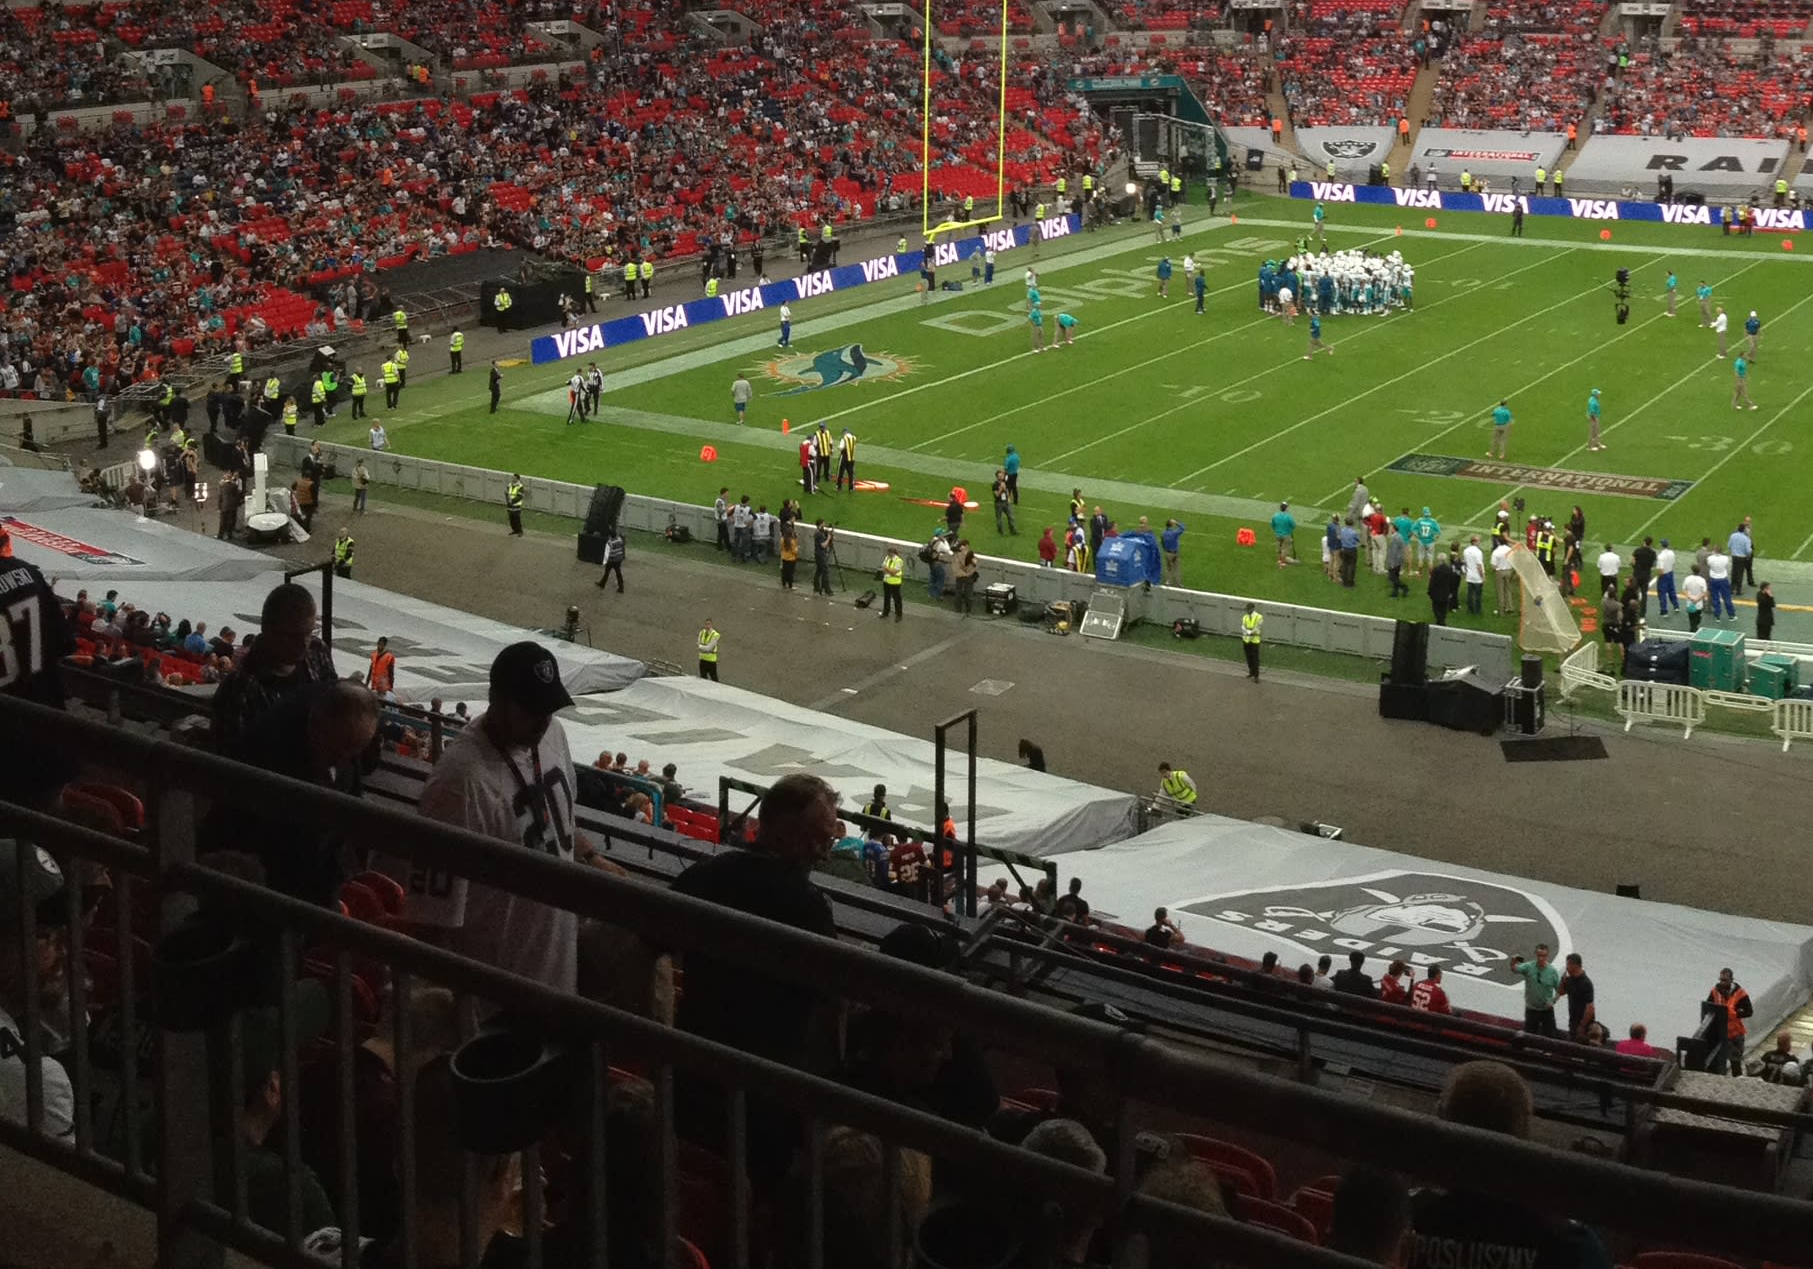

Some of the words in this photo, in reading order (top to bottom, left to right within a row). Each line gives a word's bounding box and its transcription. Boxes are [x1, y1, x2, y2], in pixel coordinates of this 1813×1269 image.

[1309, 181, 1355, 202] VISA
[1391, 187, 1441, 209] VISA
[1479, 193, 1529, 215] VISA
[1567, 198, 1619, 220] VISA
[1657, 203, 1710, 225] VISA
[1038, 214, 1070, 240] VISA
[1752, 208, 1805, 229] VISA
[981, 228, 1016, 252] VISA
[935, 242, 959, 267] ISA
[860, 253, 898, 282] VISA
[792, 269, 834, 299] VISA
[719, 286, 765, 317] VISA
[639, 304, 688, 337] VISA
[551, 324, 605, 358] VISA
[1470, 461, 1659, 493] INTERNATIONAL
[1421, 526, 1431, 536] 17
[1215, 909, 1494, 976] RAIDERS
[1412, 988, 1433, 1012] 52
